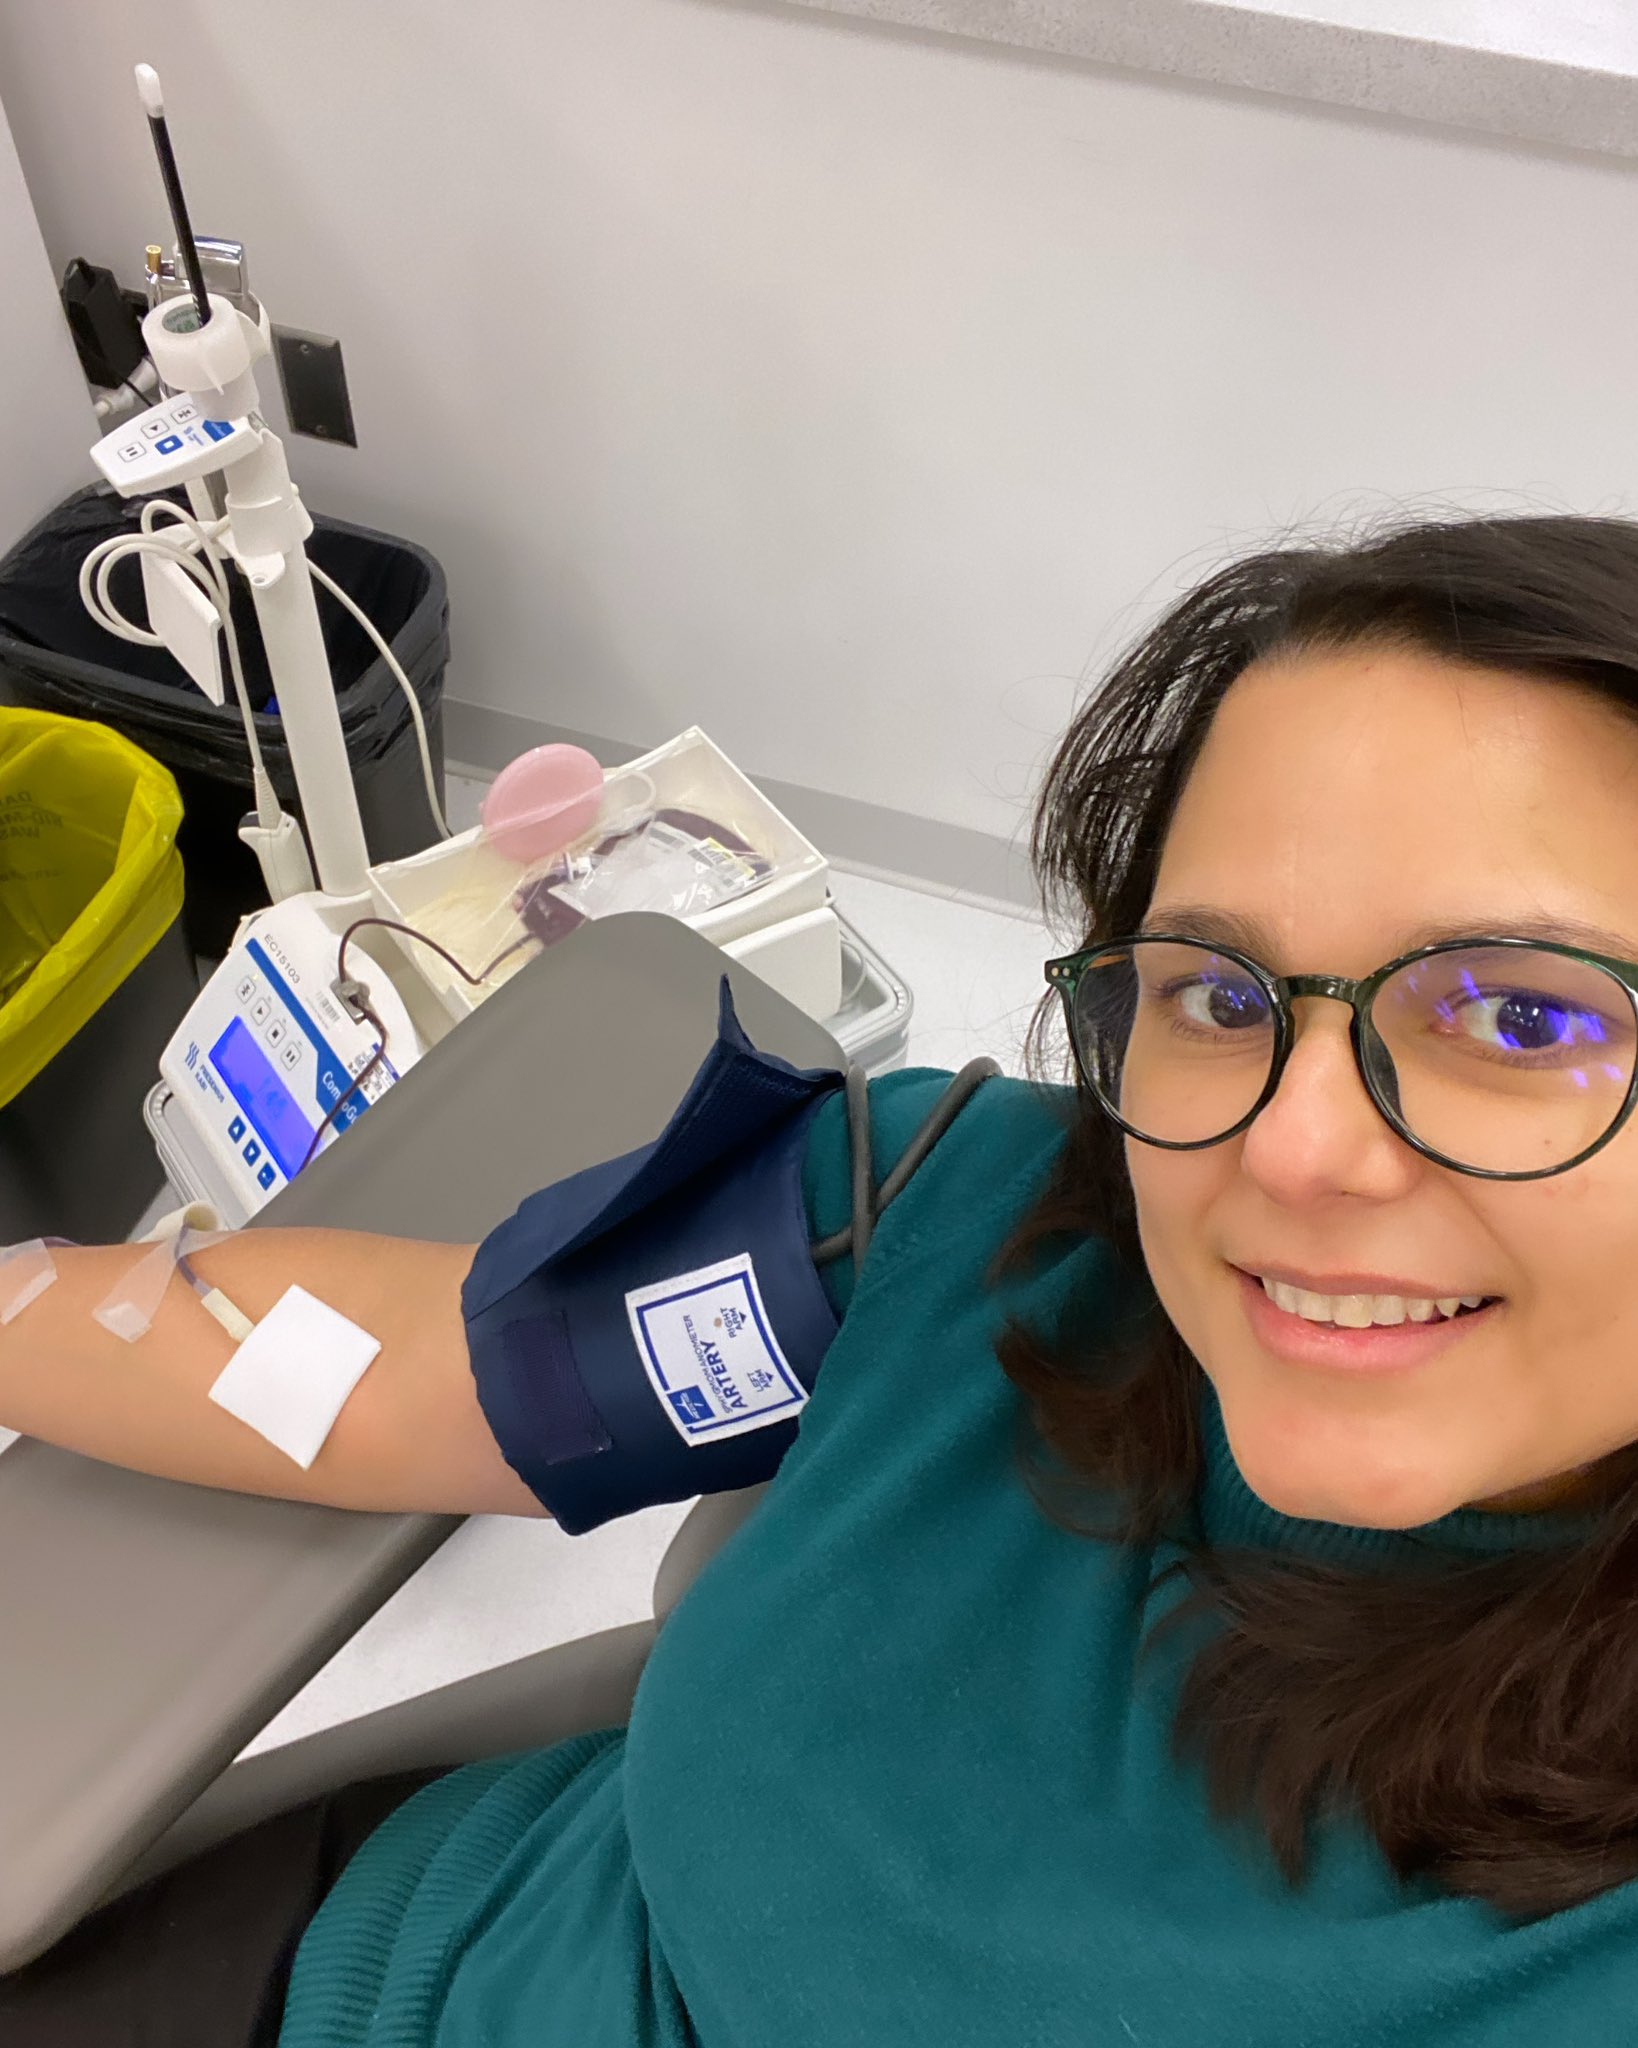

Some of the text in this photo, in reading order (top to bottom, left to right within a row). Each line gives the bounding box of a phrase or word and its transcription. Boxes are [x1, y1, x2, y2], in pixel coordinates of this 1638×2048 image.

[322, 1071, 358, 1125] ComoG
[720, 1307, 737, 1339] RIGHT
[729, 1307, 743, 1330] ARM
[700, 1340, 749, 1408] ARTERY
[747, 1372, 764, 1393] LEFT
[755, 1369, 772, 1389] ARM
